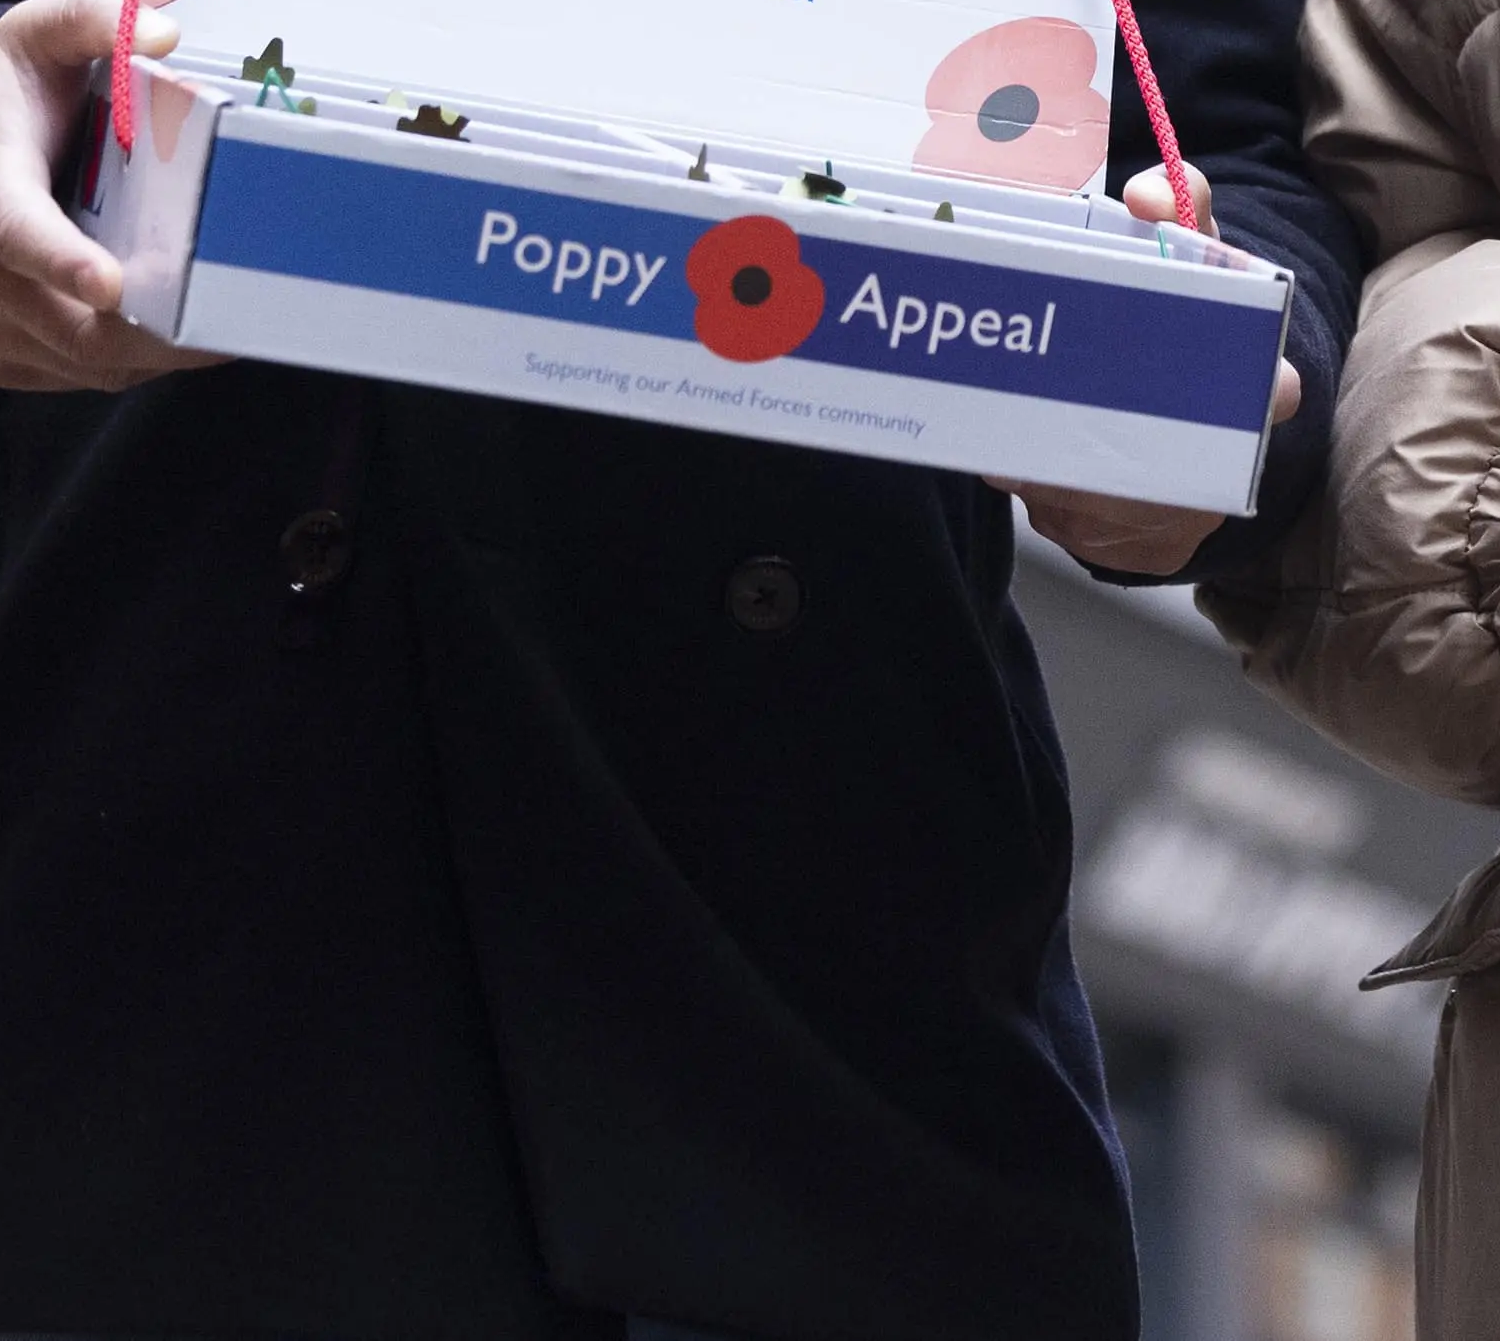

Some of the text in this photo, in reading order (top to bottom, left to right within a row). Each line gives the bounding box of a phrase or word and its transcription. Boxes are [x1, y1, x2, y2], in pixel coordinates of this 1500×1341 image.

[476, 210, 1056, 356] Poppy Appeal
[524, 351, 927, 440] Supporting our Armed Forces community
